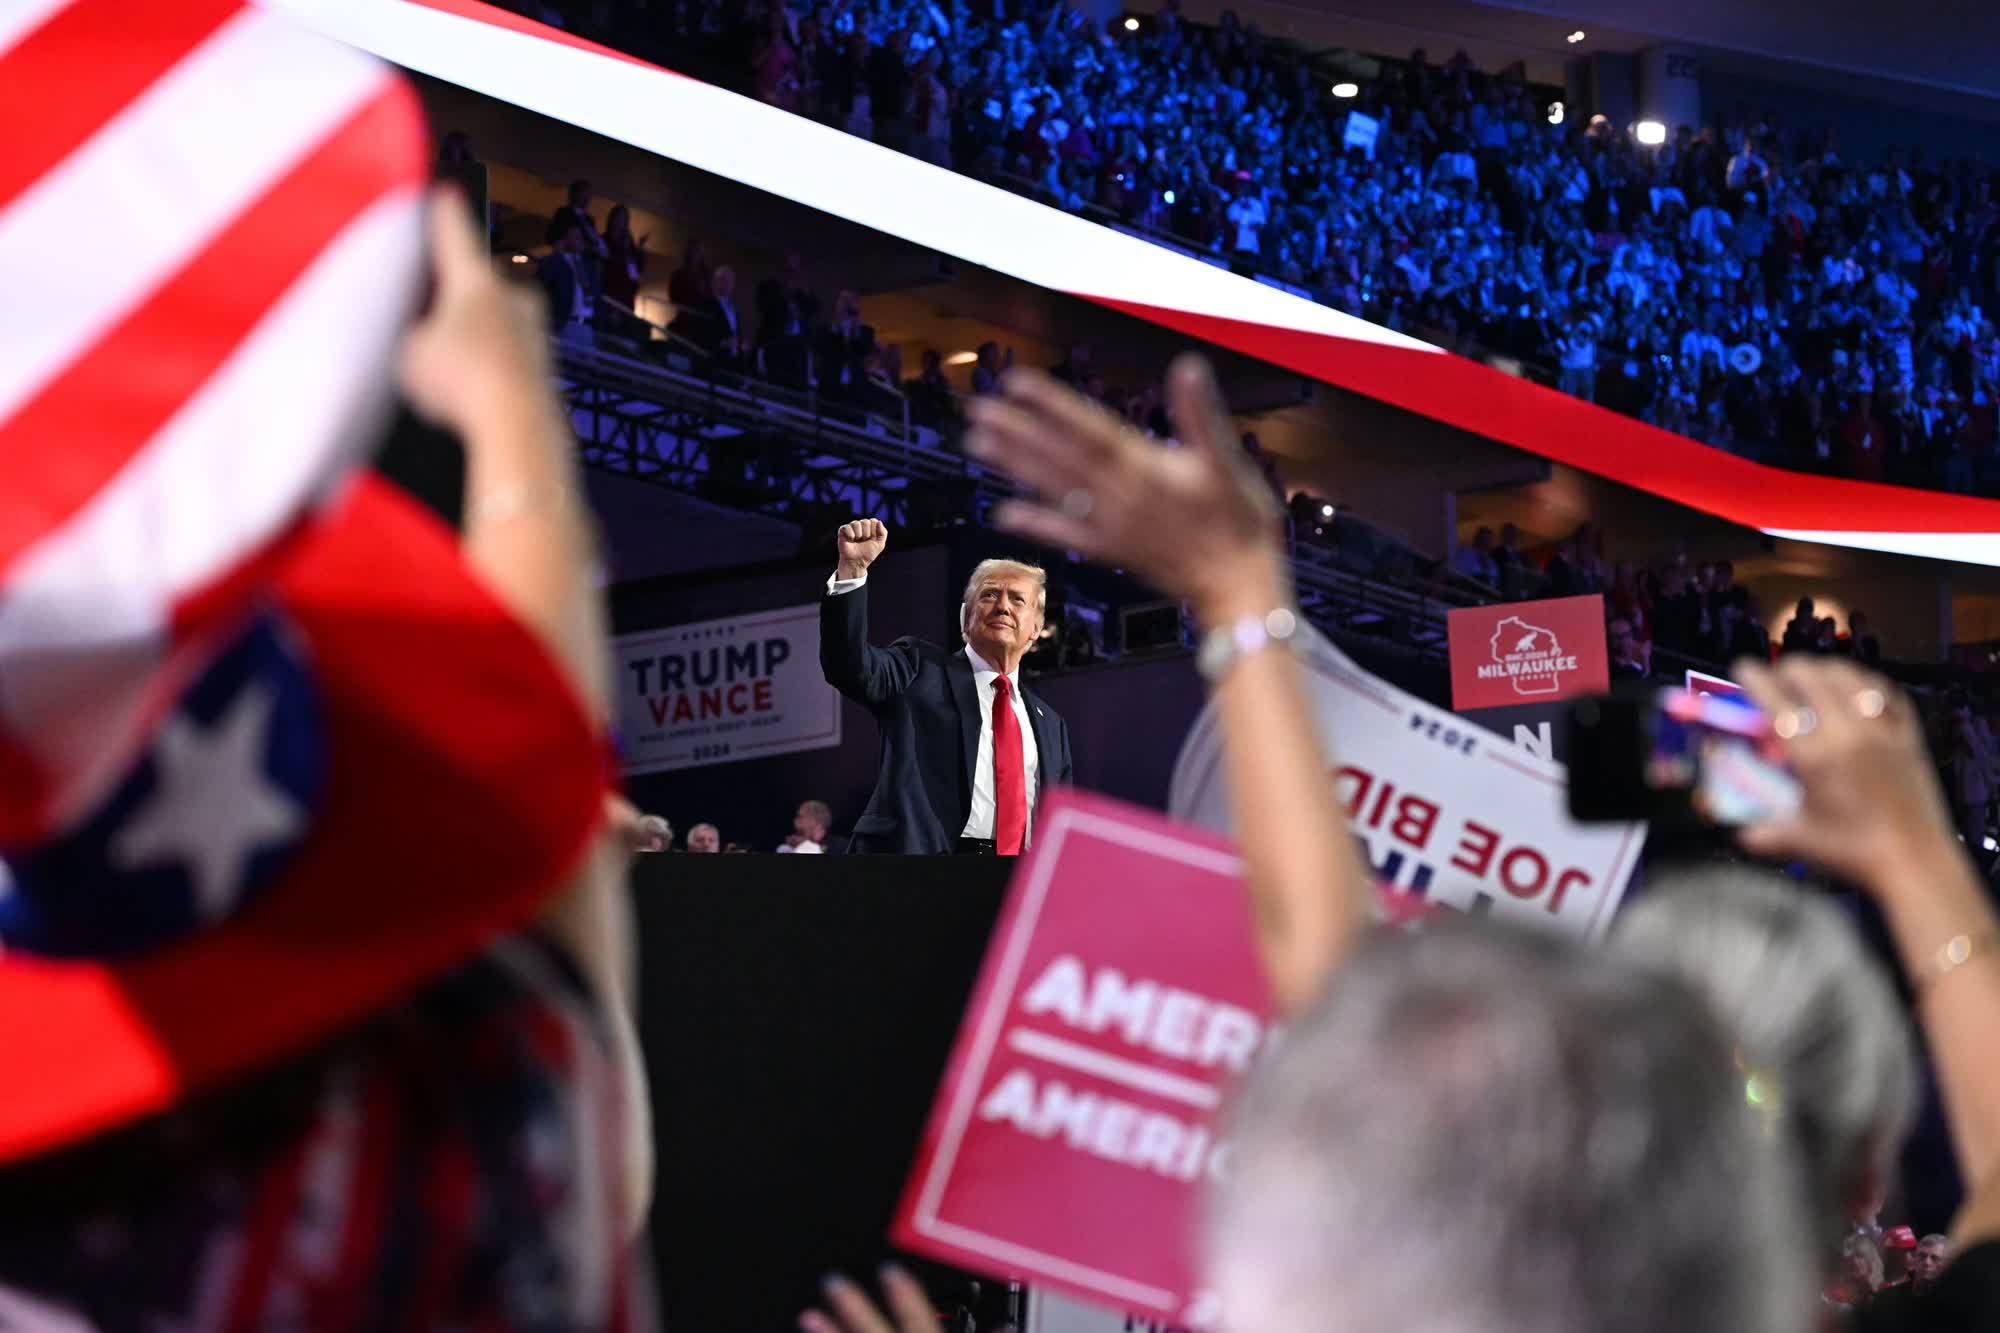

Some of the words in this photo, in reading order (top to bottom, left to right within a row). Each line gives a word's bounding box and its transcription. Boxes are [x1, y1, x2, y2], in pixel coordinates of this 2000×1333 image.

[629, 638, 790, 695] TRUMP
[1477, 656, 1578, 679] MILWAUKEE
[648, 680, 774, 728] VANCE
[1410, 713, 1479, 757] 2024
[1451, 820, 1591, 915] JOE
[1022, 953, 1284, 1073] AMER
